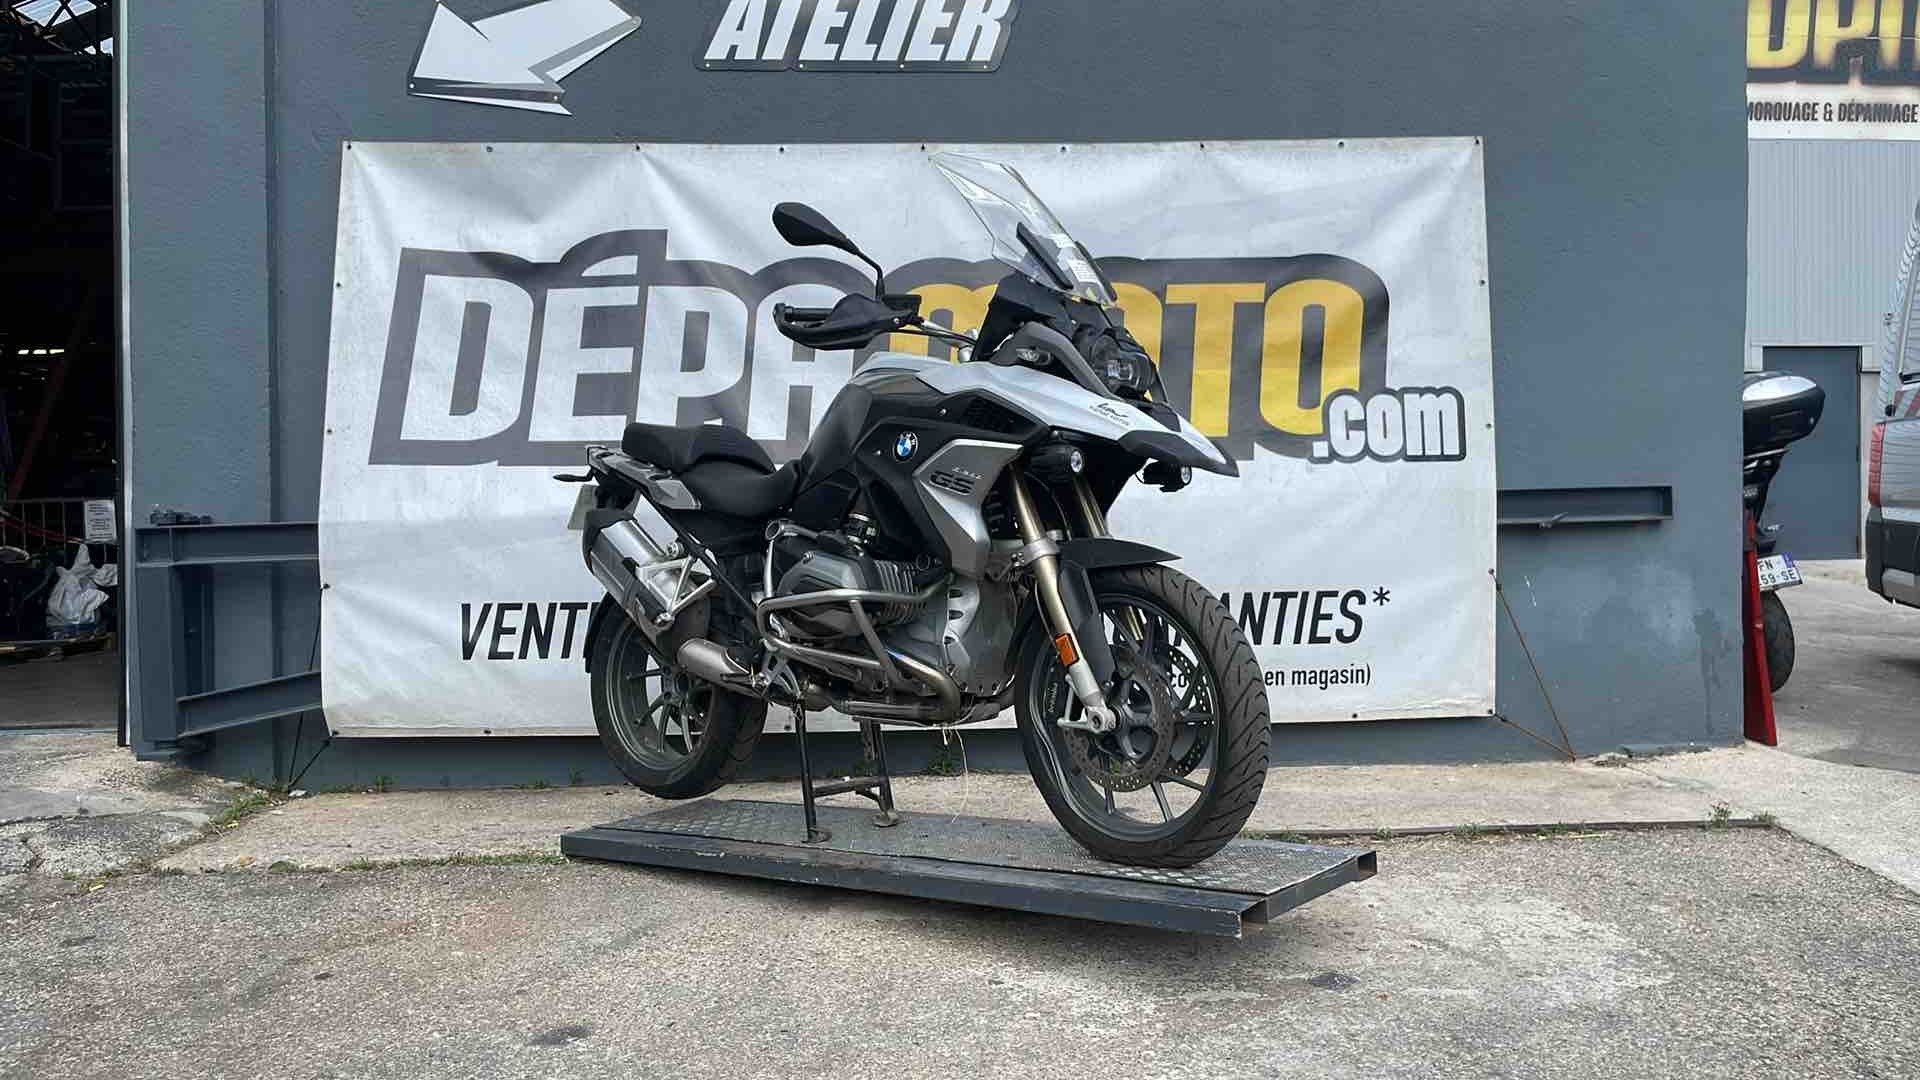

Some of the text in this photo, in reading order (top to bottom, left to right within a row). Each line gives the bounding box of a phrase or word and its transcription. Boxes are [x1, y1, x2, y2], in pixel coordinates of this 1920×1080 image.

[704, 0, 1008, 61] ATELIER
[1823, 103, 1833, 122] &
[1838, 98, 1919, 123] DÉPANNAGE
[461, 602, 600, 660] VENT
[1264, 663, 1371, 690] en magasin)
